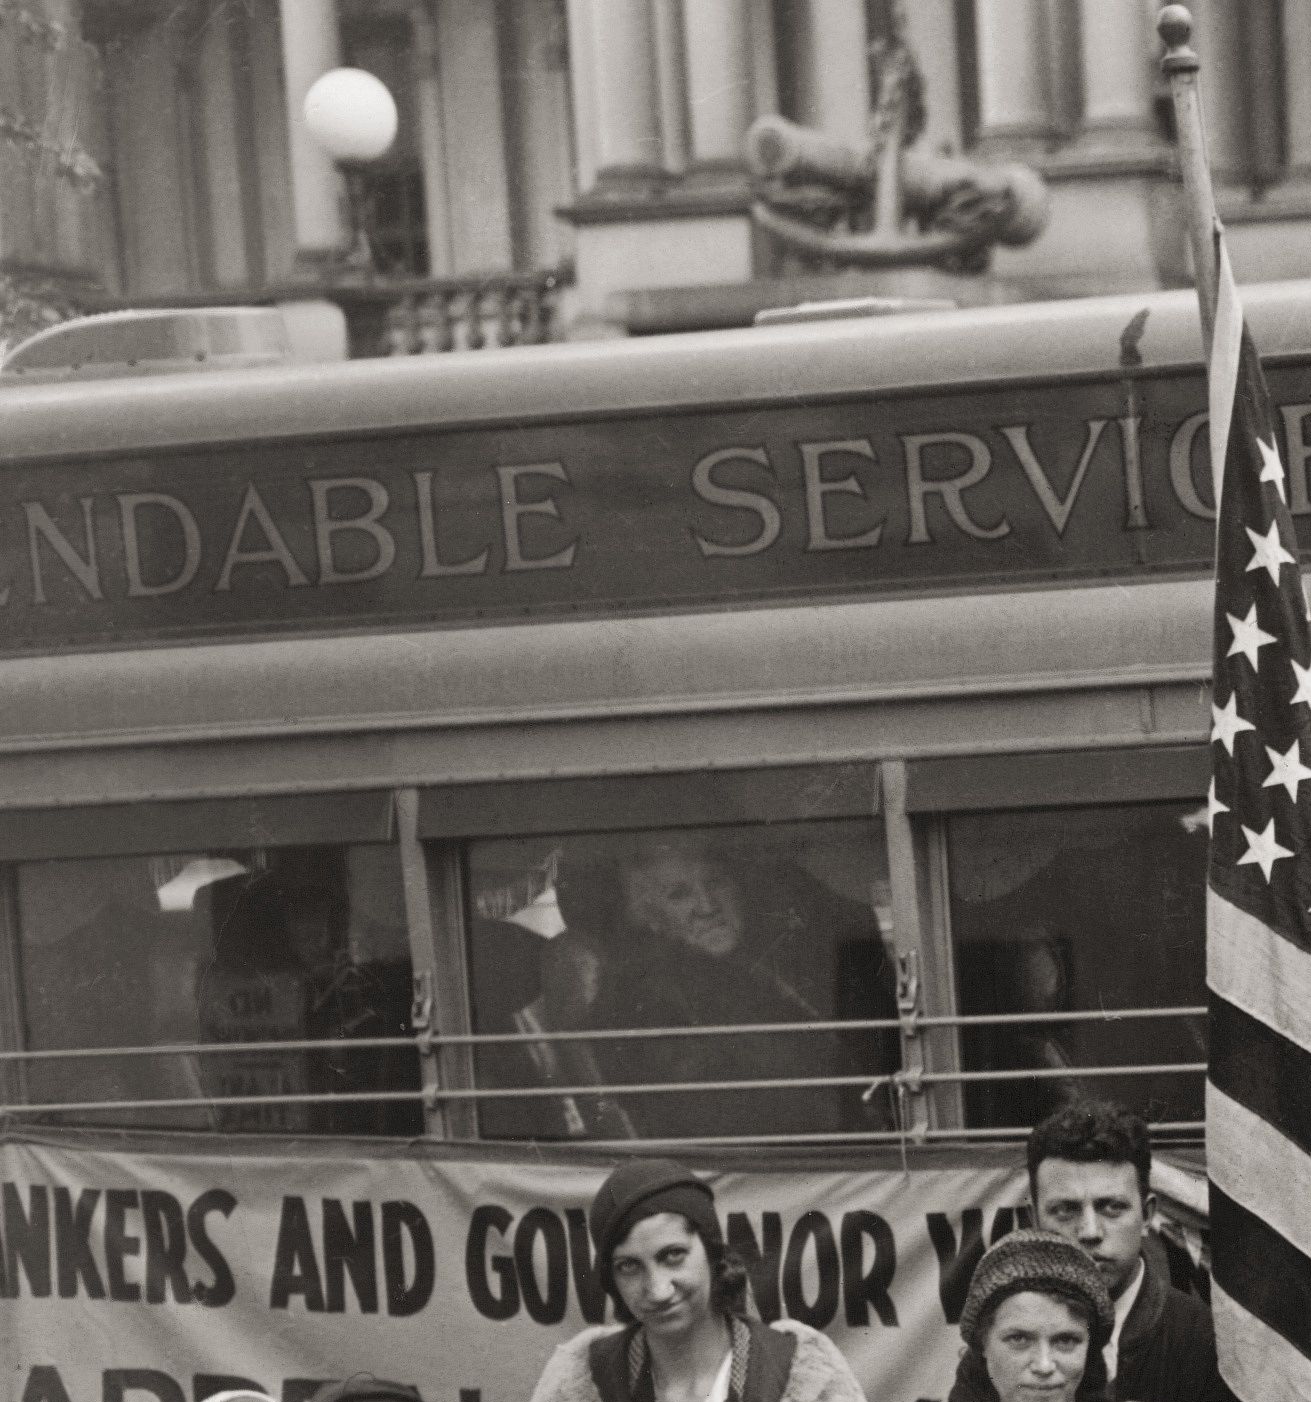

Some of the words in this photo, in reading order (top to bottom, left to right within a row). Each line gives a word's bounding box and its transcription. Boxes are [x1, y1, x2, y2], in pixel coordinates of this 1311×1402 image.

[0, 460, 580, 602] NDABLE
[0, 1181, 239, 1308] NKERS
[270, 1196, 436, 1318] AND
[464, 1203, 899, 1330] GOVNOR
